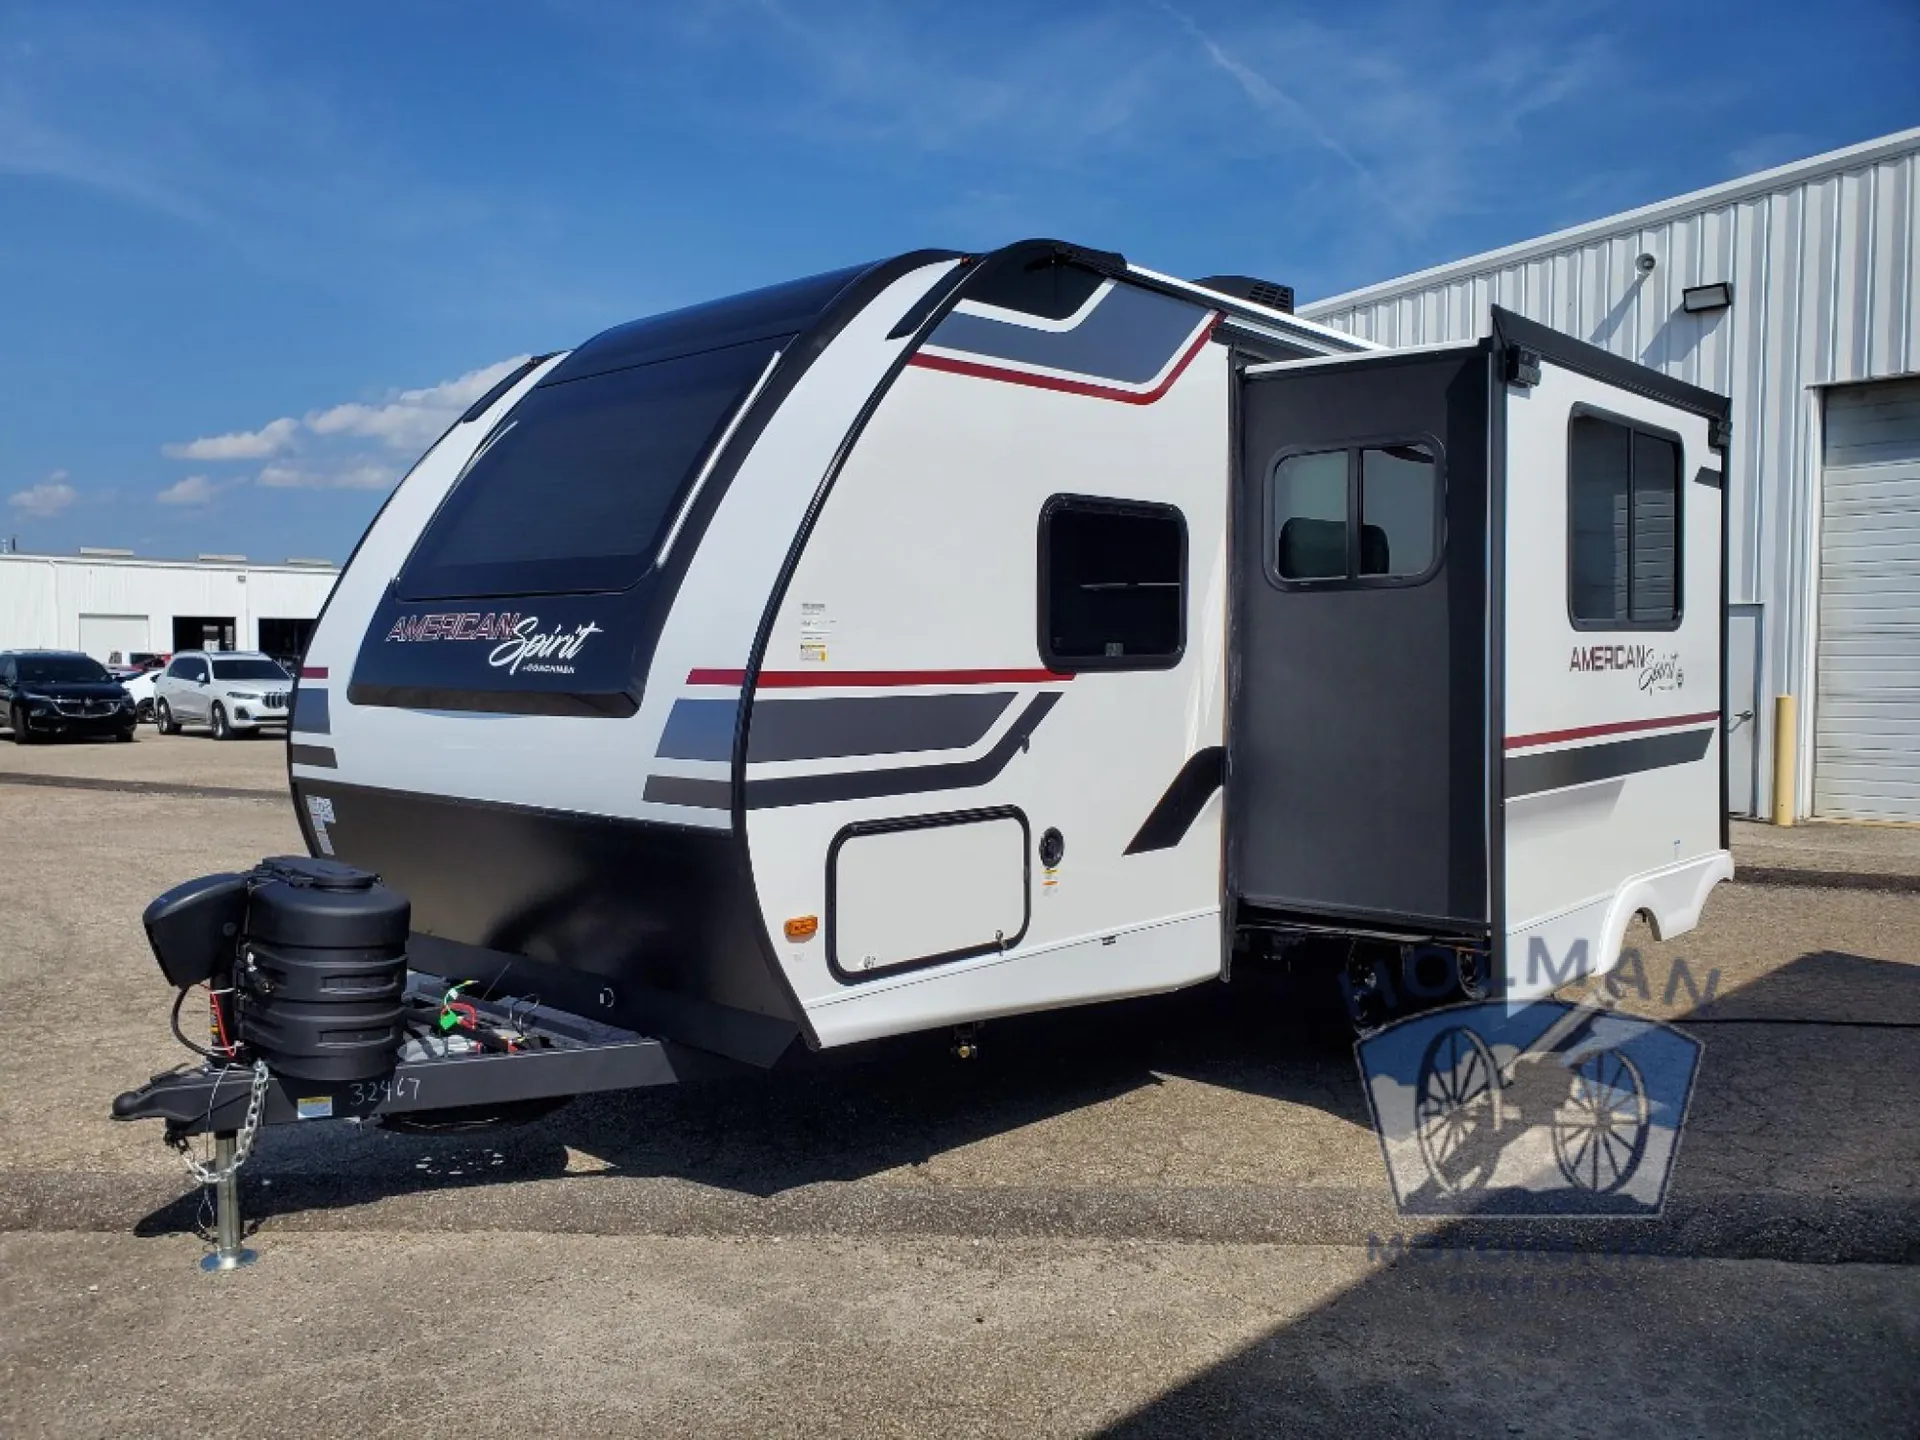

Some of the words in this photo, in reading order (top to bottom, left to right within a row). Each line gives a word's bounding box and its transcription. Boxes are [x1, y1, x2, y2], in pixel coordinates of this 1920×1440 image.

[385, 612, 521, 642] AMERICAN
[488, 616, 604, 676] Spirit
[1570, 644, 1646, 672] AMERICAN
[1639, 648, 1680, 696] Spirit
